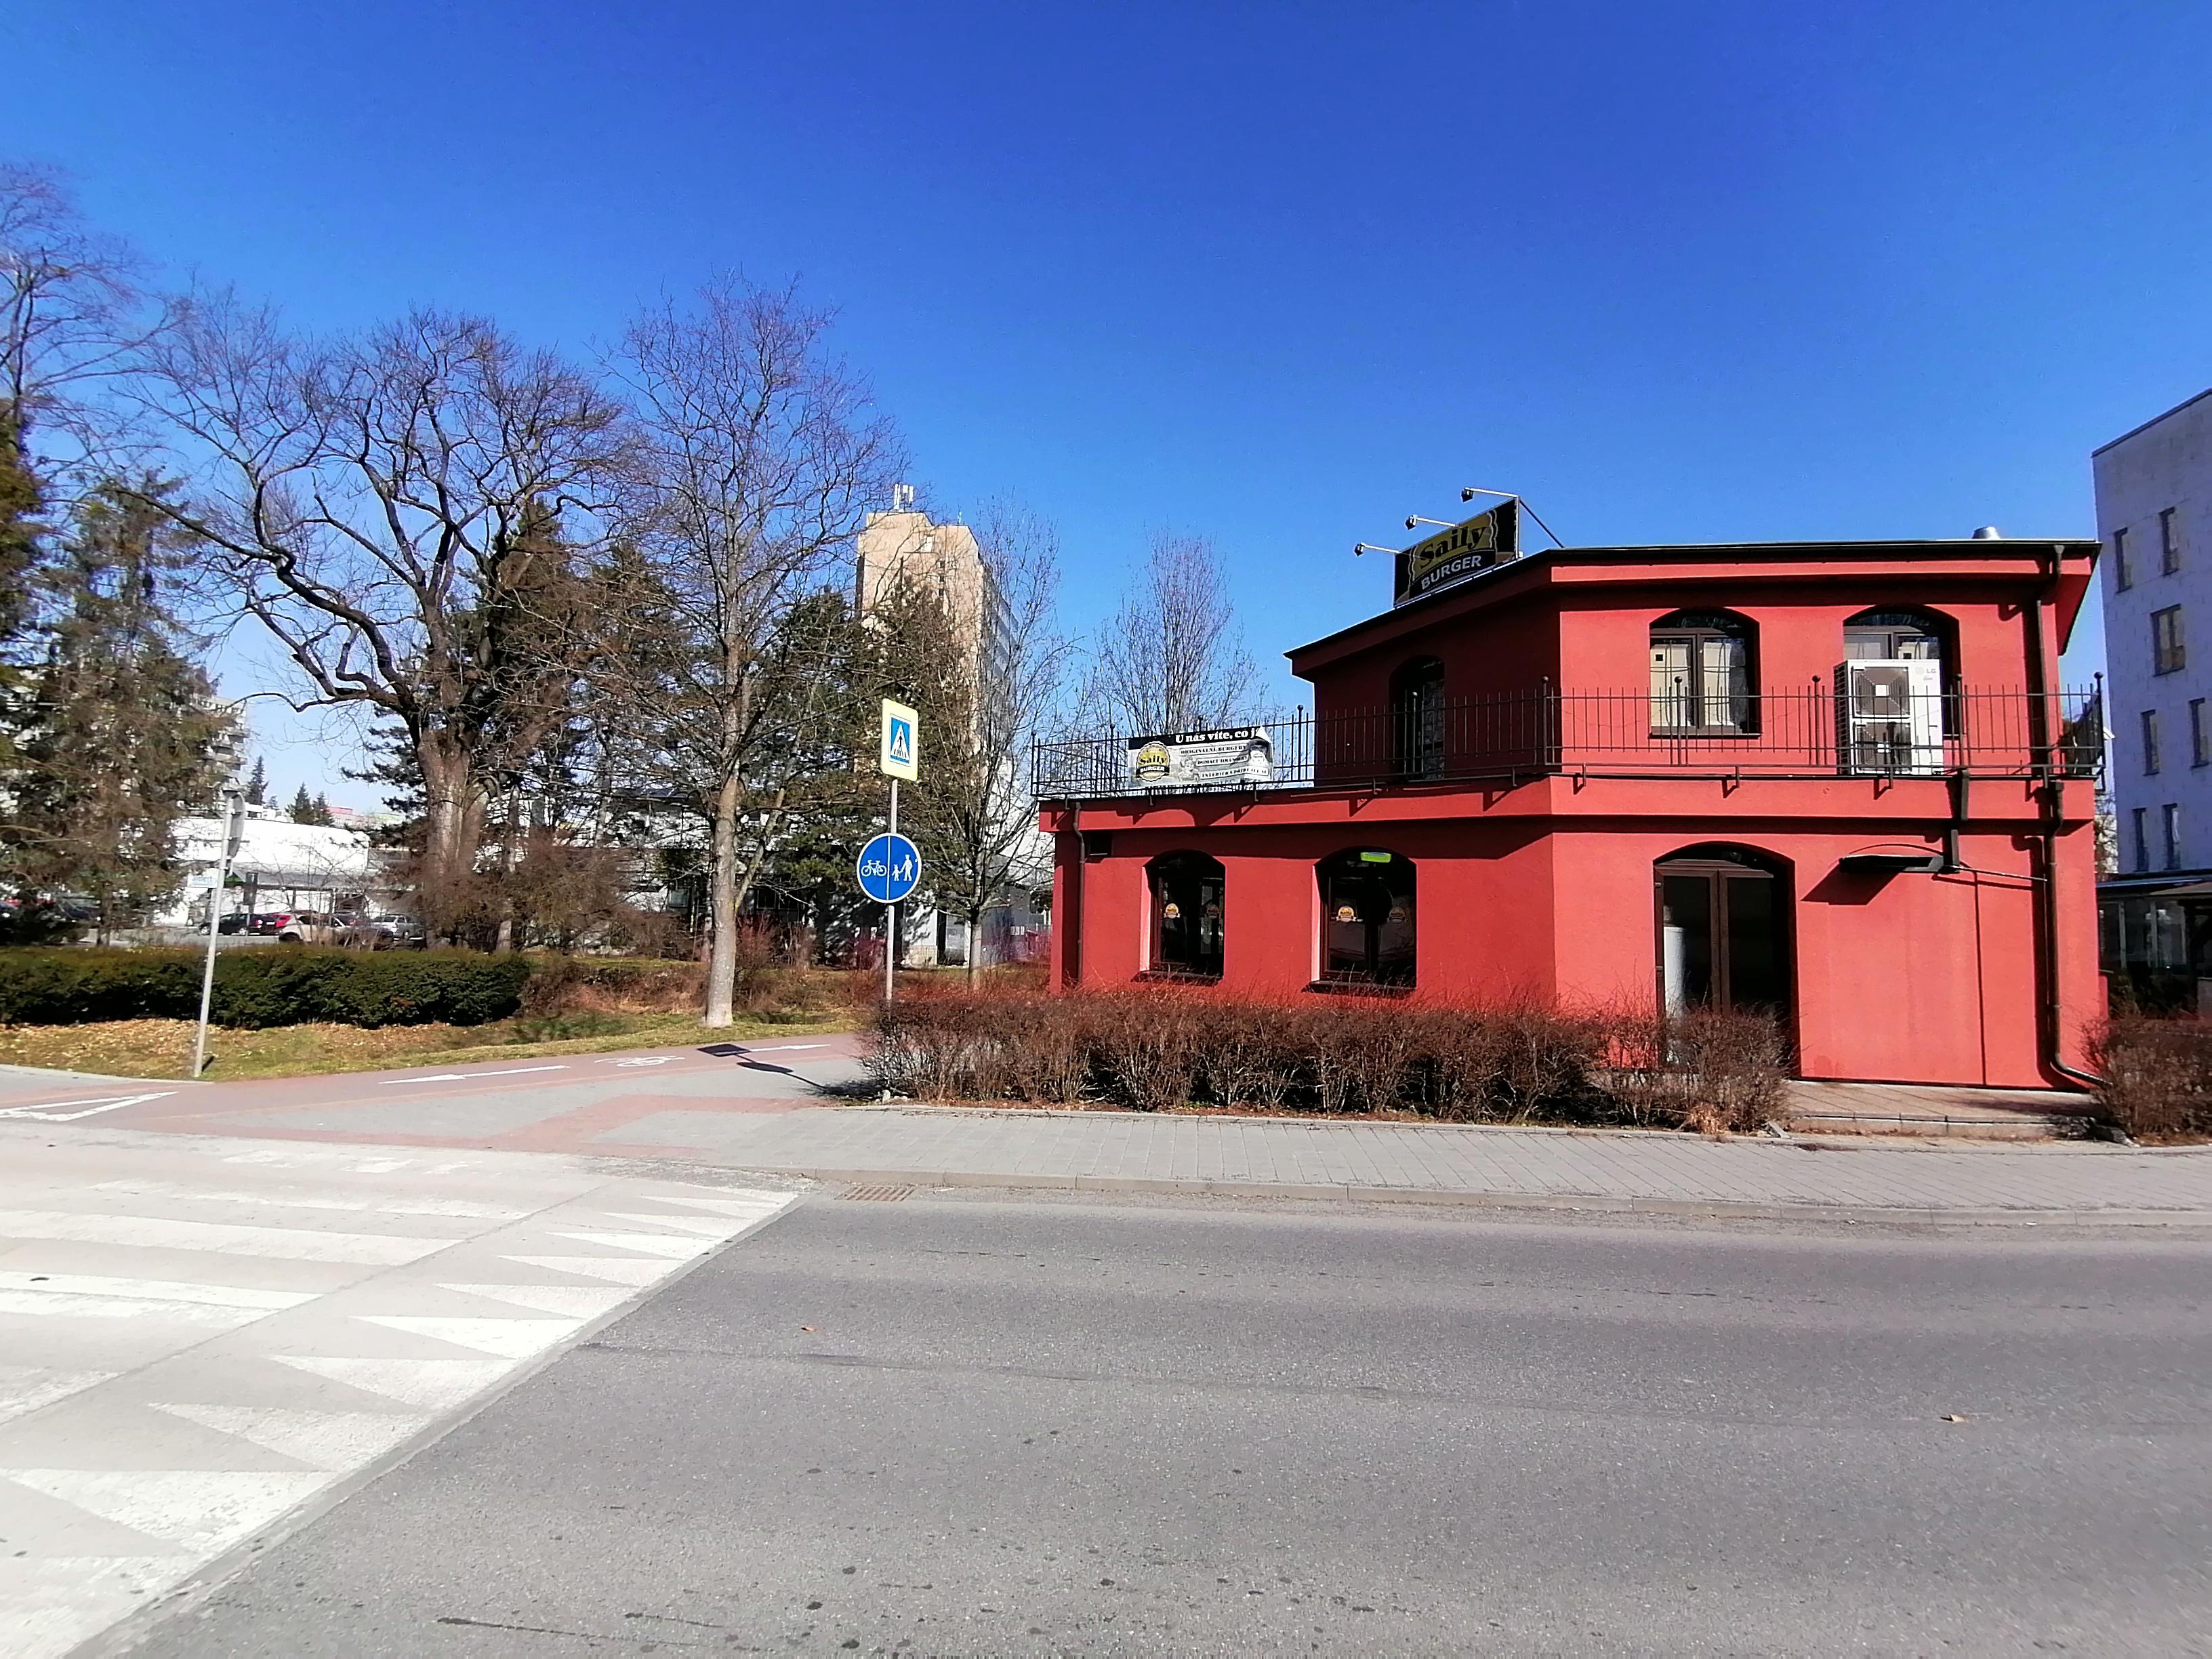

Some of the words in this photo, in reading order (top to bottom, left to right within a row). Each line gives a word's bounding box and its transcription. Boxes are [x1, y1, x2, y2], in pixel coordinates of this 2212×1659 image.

[1419, 526, 1486, 570] Saily
[1421, 555, 1481, 590] BURGER
[1175, 734, 1184, 743] U
[1185, 733, 1206, 741] nás
[1235, 730, 1248, 738] co
[1139, 755, 1166, 765] Saily
